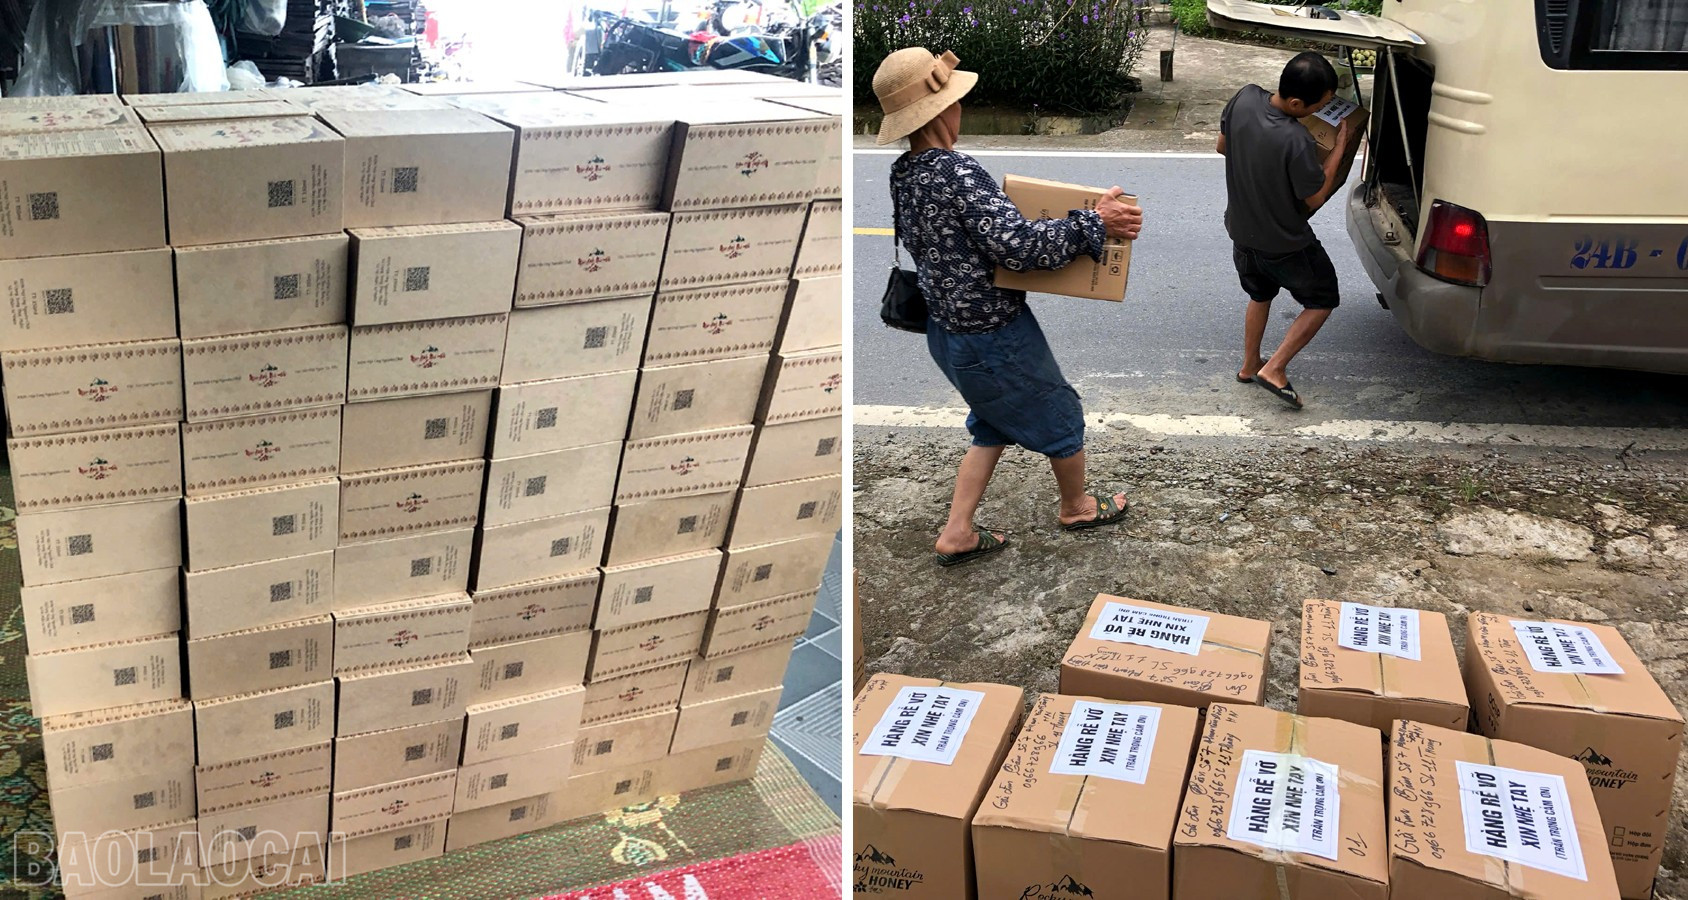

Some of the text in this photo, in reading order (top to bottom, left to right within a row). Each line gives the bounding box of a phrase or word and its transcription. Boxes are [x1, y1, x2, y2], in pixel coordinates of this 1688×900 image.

[1570, 234, 1640, 270] 24B
[1103, 624, 1122, 635] VỠ
[1112, 614, 1187, 632] XIN NHẸ TAY
[1149, 631, 1191, 645] HÀNG
[1540, 645, 1563, 667] HÀNG
[881, 720, 911, 747] HÀNG
[908, 691, 928, 704] VỠ
[911, 694, 951, 747] XIN NHẸ TAY
[1068, 737, 1095, 767] HÀNG
[1083, 707, 1105, 722] VỠ
[1099, 711, 1129, 765] XIN NHẸ TAY
[1255, 759, 1278, 777] VỠ
[1586, 768, 1639, 781] mountain
[1420, 772, 1436, 787] SL
[1471, 771, 1497, 788] VỠ
[1281, 765, 1308, 833] XIN NHẸ TAY
[1246, 797, 1272, 834] HÀNG
[1508, 780, 1542, 850] XIN NHẸ TAY
[1546, 814, 1563, 837] TRỌNG
[1480, 809, 1508, 848] HÀNG
[868, 875, 913, 890] HONEY
[871, 867, 924, 881] mountain
